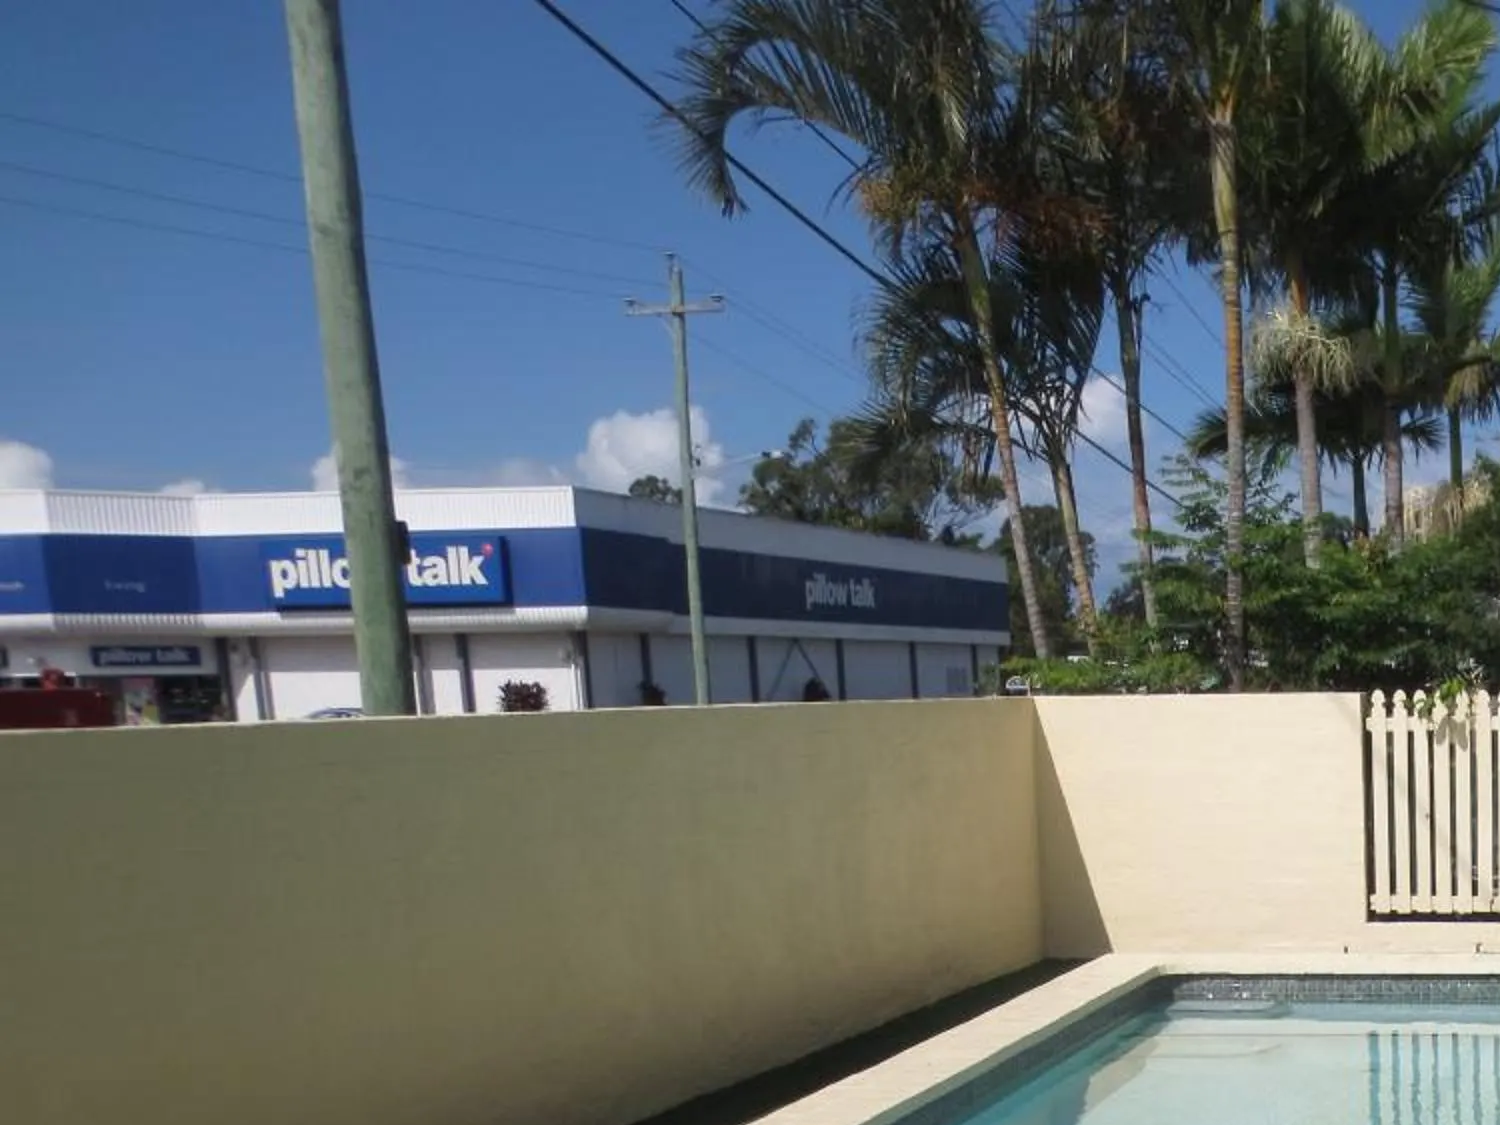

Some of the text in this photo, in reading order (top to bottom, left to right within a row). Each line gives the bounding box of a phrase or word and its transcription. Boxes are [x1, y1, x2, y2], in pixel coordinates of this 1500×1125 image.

[269, 545, 489, 598] pillo talk
[805, 572, 875, 612] pillow talk
